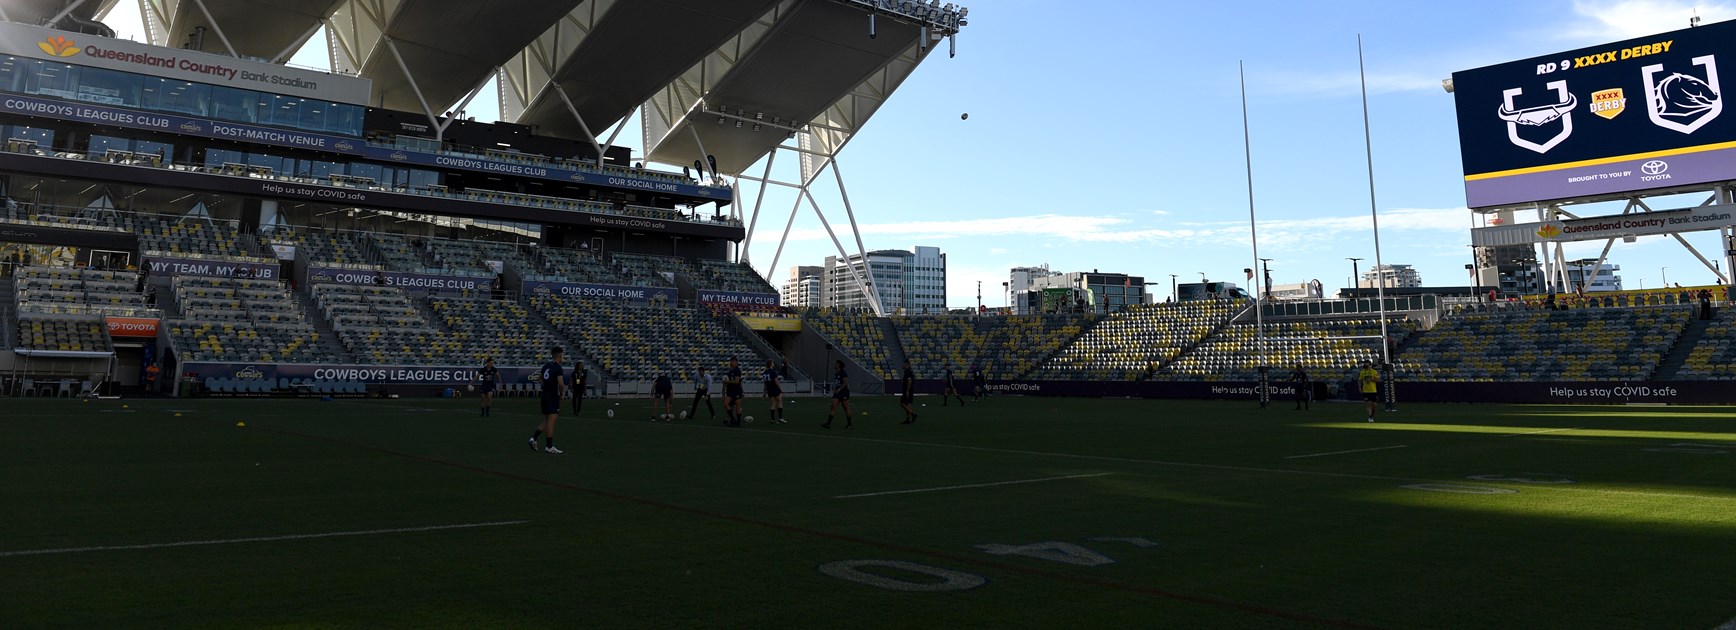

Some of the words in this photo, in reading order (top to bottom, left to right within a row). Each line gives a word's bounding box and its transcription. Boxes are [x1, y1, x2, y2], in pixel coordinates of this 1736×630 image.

[1536, 62, 1557, 75] RD
[1560, 59, 1571, 71] 9
[1573, 50, 1618, 69] XXXX
[1620, 40, 1674, 60] DERBY
[84, 45, 176, 69] Queensland
[179, 59, 237, 80] Country
[241, 70, 269, 83] Bank
[271, 75, 317, 90] Stadium
[1595, 91, 1619, 101] XXXX
[1589, 97, 1627, 113] DERBY
[5, 99, 73, 116] COWBOYS
[76, 108, 133, 123] LEAGUES
[136, 116, 169, 128] CLUB
[213, 125, 285, 142] POST-MATCH
[289, 135, 325, 147] VENUE
[436, 157, 481, 169] COWBOYS
[483, 162, 522, 173] LEAGUES
[524, 168, 547, 177] CLUB
[1568, 174, 1598, 183] BROUGHT
[1640, 173, 1672, 182] TOYOTA
[608, 177, 626, 186] OUR
[626, 180, 654, 190] SOCIAL
[655, 183, 678, 192] HOME
[262, 183, 283, 194] Help
[297, 187, 316, 197] stay
[317, 189, 346, 199] COVID
[347, 192, 366, 201] safe
[590, 216, 605, 225] Help
[615, 218, 629, 227] stay
[629, 220, 651, 228] COVID
[1562, 222, 1622, 234] Queensland
[1623, 217, 1666, 229] Country
[1668, 216, 1691, 225] Bank
[1692, 212, 1731, 223] Stadium
[149, 261, 169, 271] MY
[173, 263, 212, 275] TEAM,
[216, 265, 236, 275] MY
[238, 267, 272, 278] CUB
[335, 273, 394, 285] COWBOS
[396, 276, 444, 288] LEAGUES
[447, 279, 475, 290] CLUB
[561, 286, 581, 296] OUR
[583, 287, 615, 297] SOCIAL
[617, 289, 644, 298] HOME
[702, 293, 714, 302] MY
[716, 294, 740, 304] TEAM,
[741, 296, 753, 304] MY
[754, 296, 775, 305] CLUB
[121, 323, 156, 331] TOYOTA
[313, 368, 387, 381] COWBOYS
[390, 369, 450, 381] LEAGUES
[543, 369, 550, 380] 6
[999, 384, 1010, 392] stay
[1010, 383, 1028, 391] COVID
[1029, 383, 1040, 391] safe
[1212, 385, 1228, 395] Help
[1229, 387, 1237, 395] us
[1238, 386, 1253, 396] stay
[1279, 386, 1296, 395] safe
[1549, 386, 1574, 398] Help
[1576, 388, 1588, 397] us
[1589, 387, 1612, 398] stay
[1613, 386, 1650, 397] COVID
[1652, 386, 1678, 397] safe
